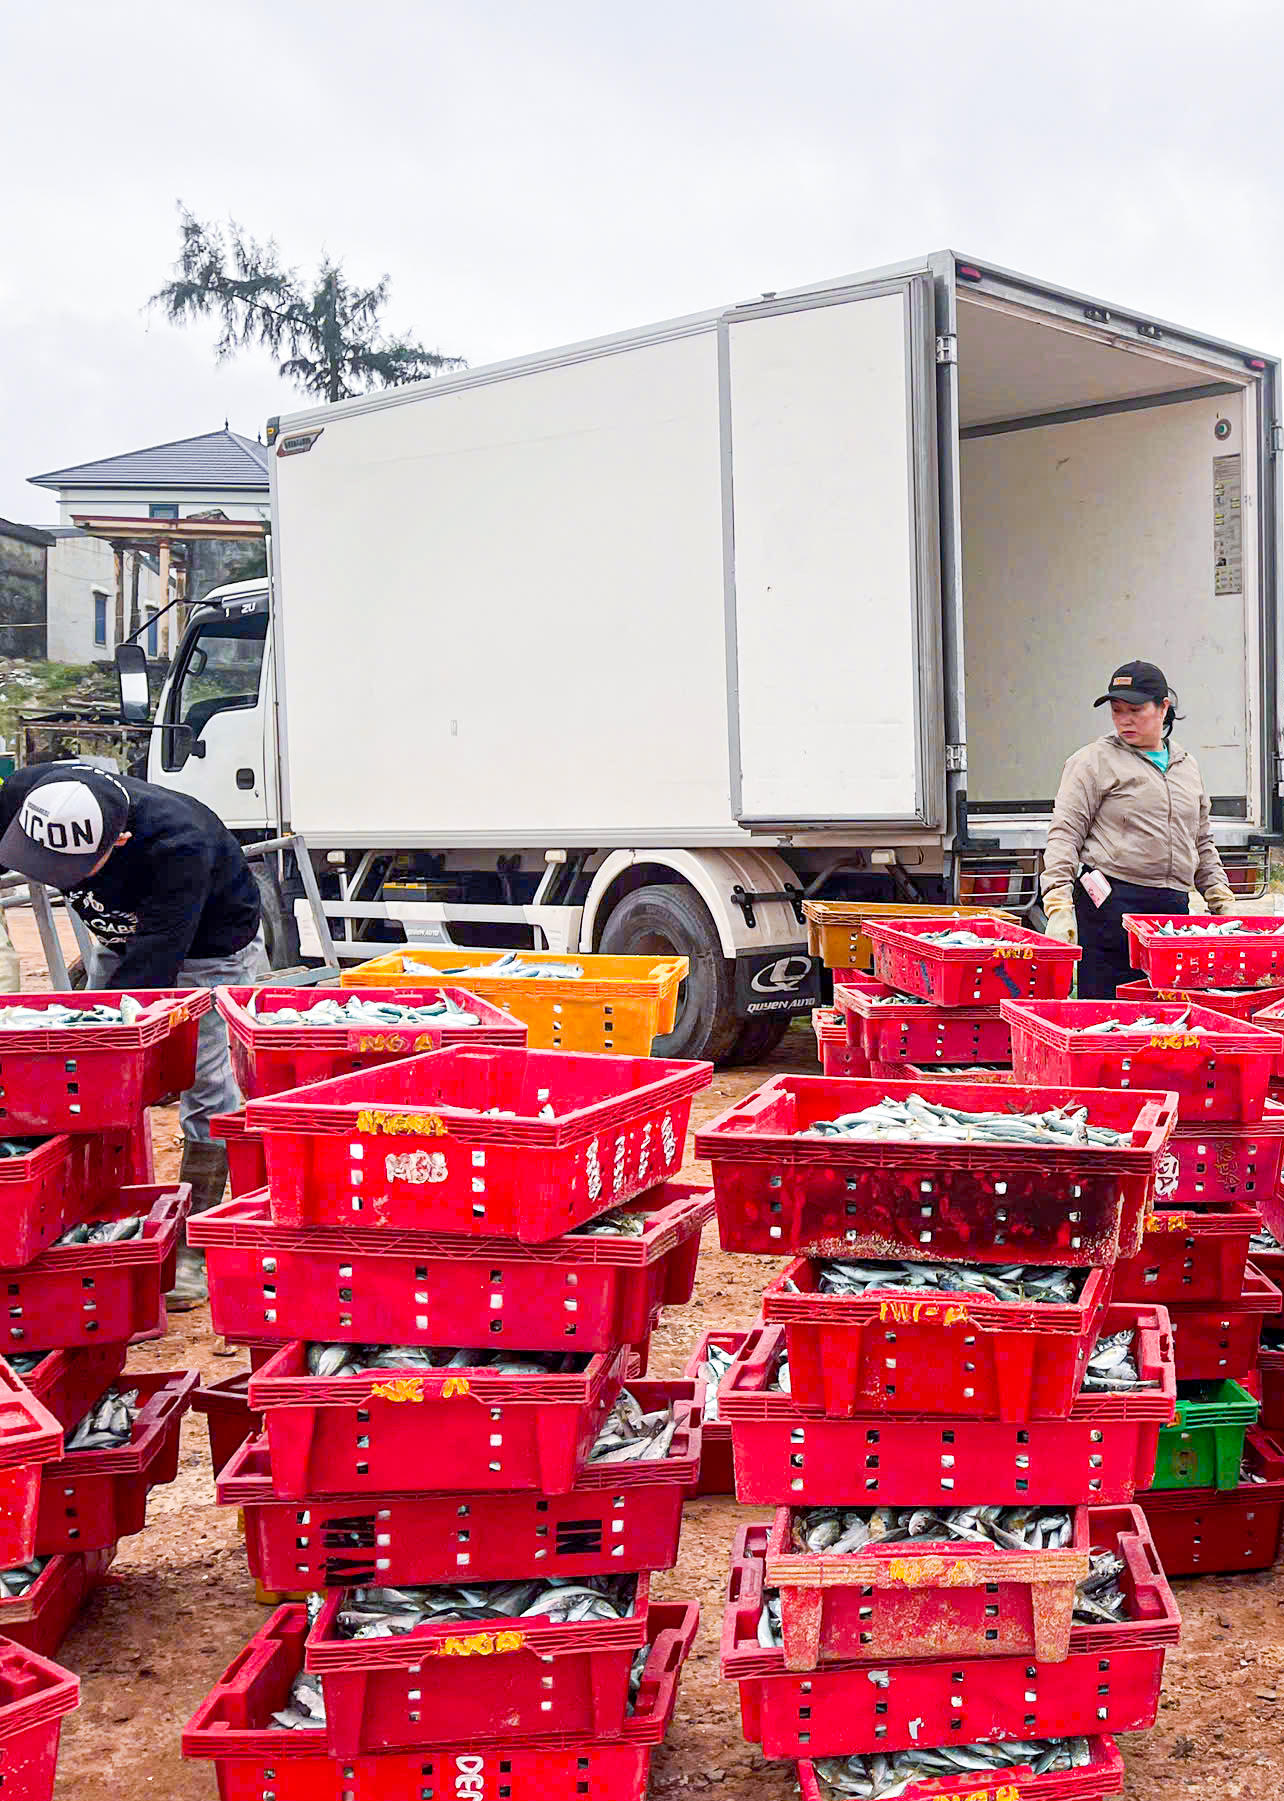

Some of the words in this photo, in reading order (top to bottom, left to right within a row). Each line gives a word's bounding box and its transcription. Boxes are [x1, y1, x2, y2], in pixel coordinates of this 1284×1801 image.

[24, 809, 94, 849] ICON
[747, 1000, 789, 1014] QUYEN
[788, 997, 815, 1010] AUTO
